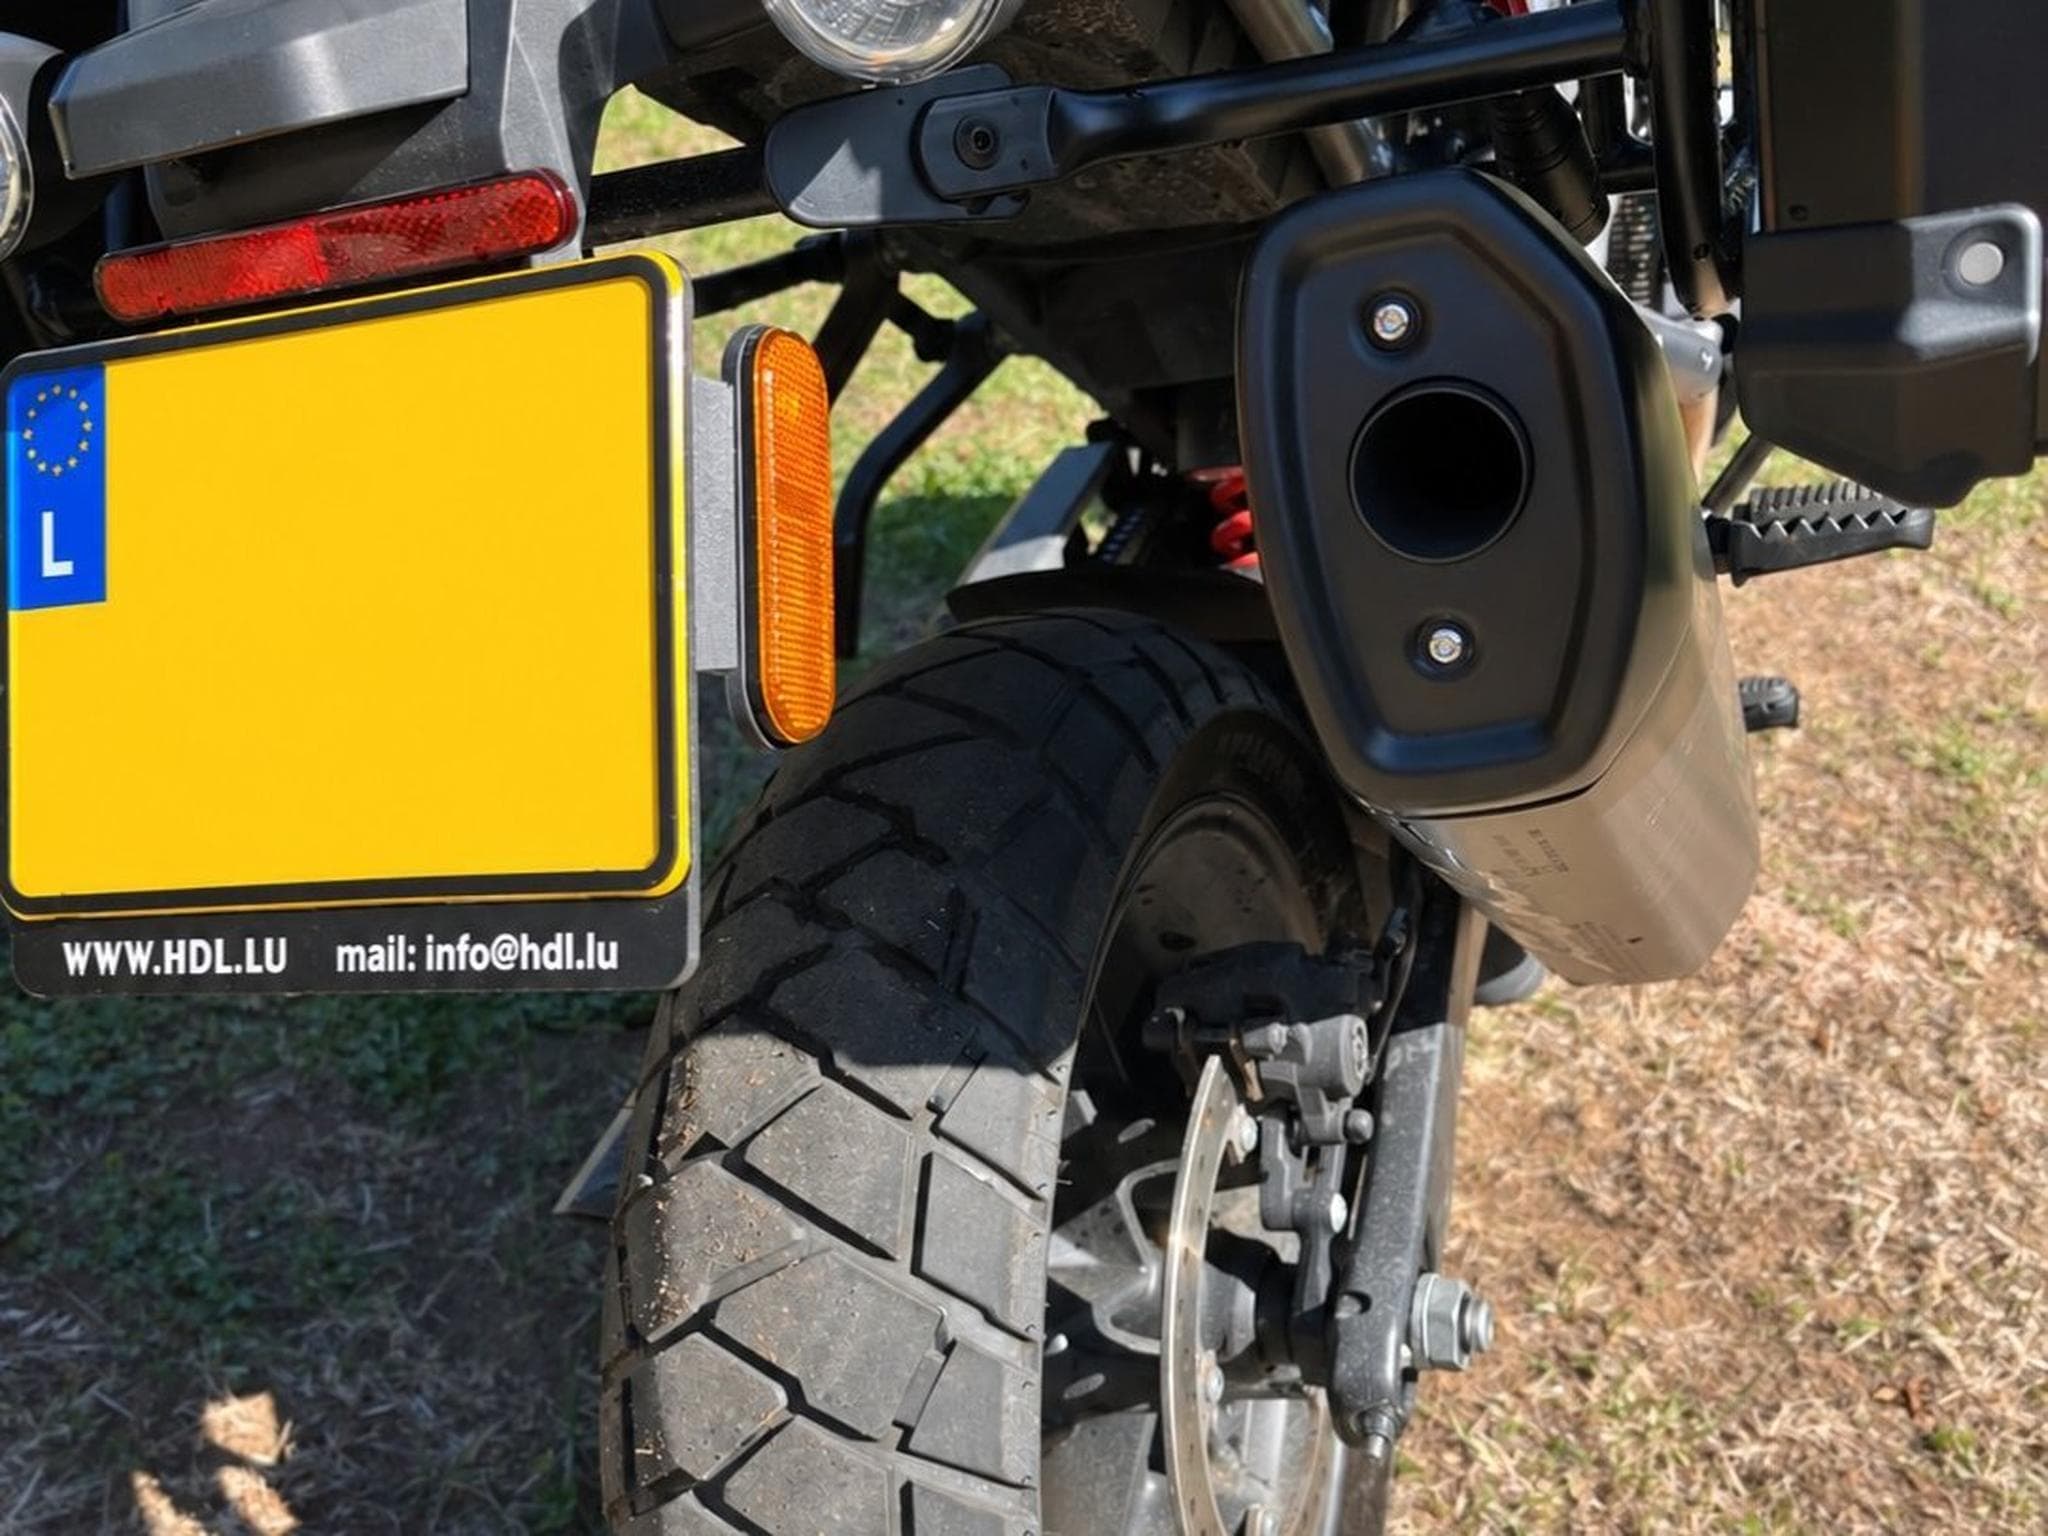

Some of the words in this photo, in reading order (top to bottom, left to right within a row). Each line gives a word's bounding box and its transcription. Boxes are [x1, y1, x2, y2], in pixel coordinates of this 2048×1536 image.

[41, 511, 74, 578] L
[62, 937, 288, 977] WWW.HDL.LU
[336, 934, 417, 973] mail:
[425, 932, 619, 973] info@hdl.lu
